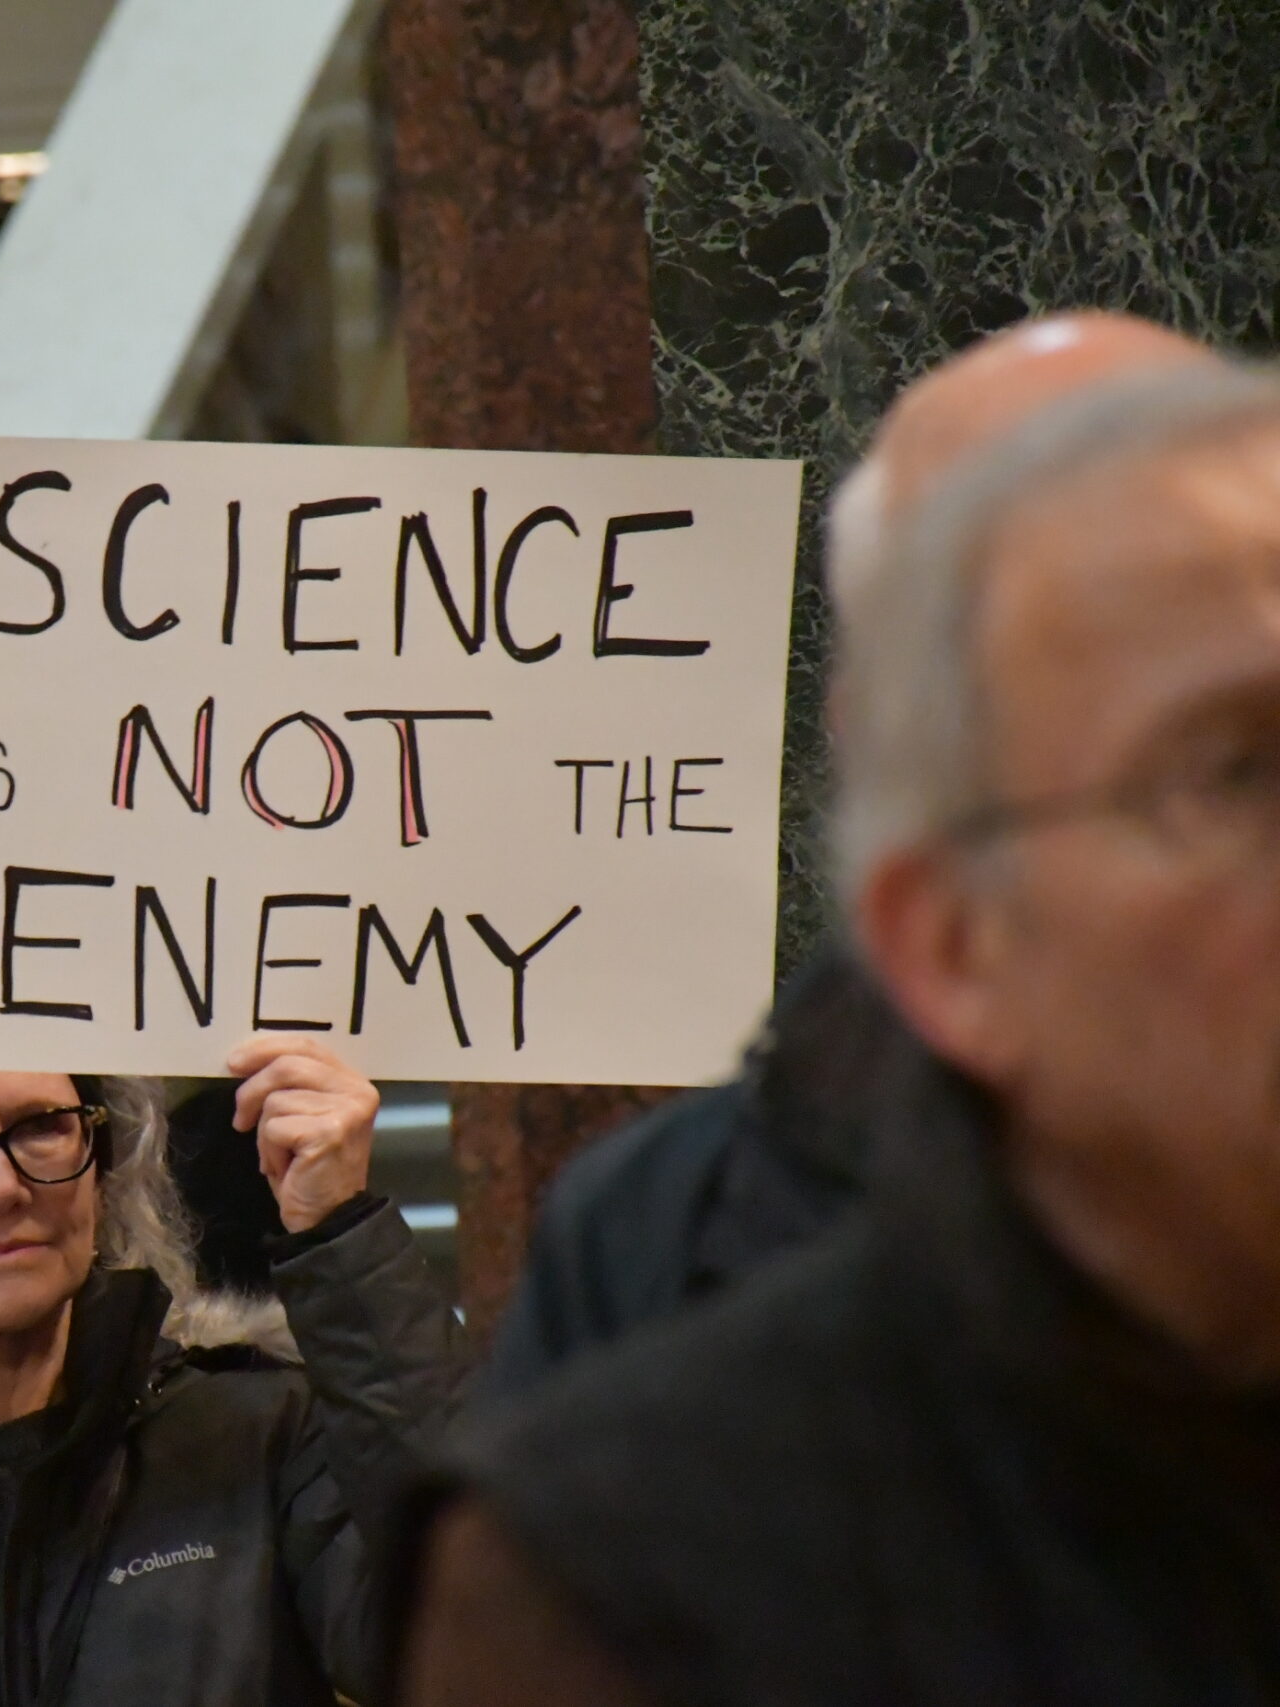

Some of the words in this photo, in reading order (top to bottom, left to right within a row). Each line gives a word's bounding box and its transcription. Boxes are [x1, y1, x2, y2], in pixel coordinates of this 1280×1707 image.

[111, 697, 493, 848] NOT
[554, 756, 734, 839] THE
[127, 1541, 216, 1576] Columbia
